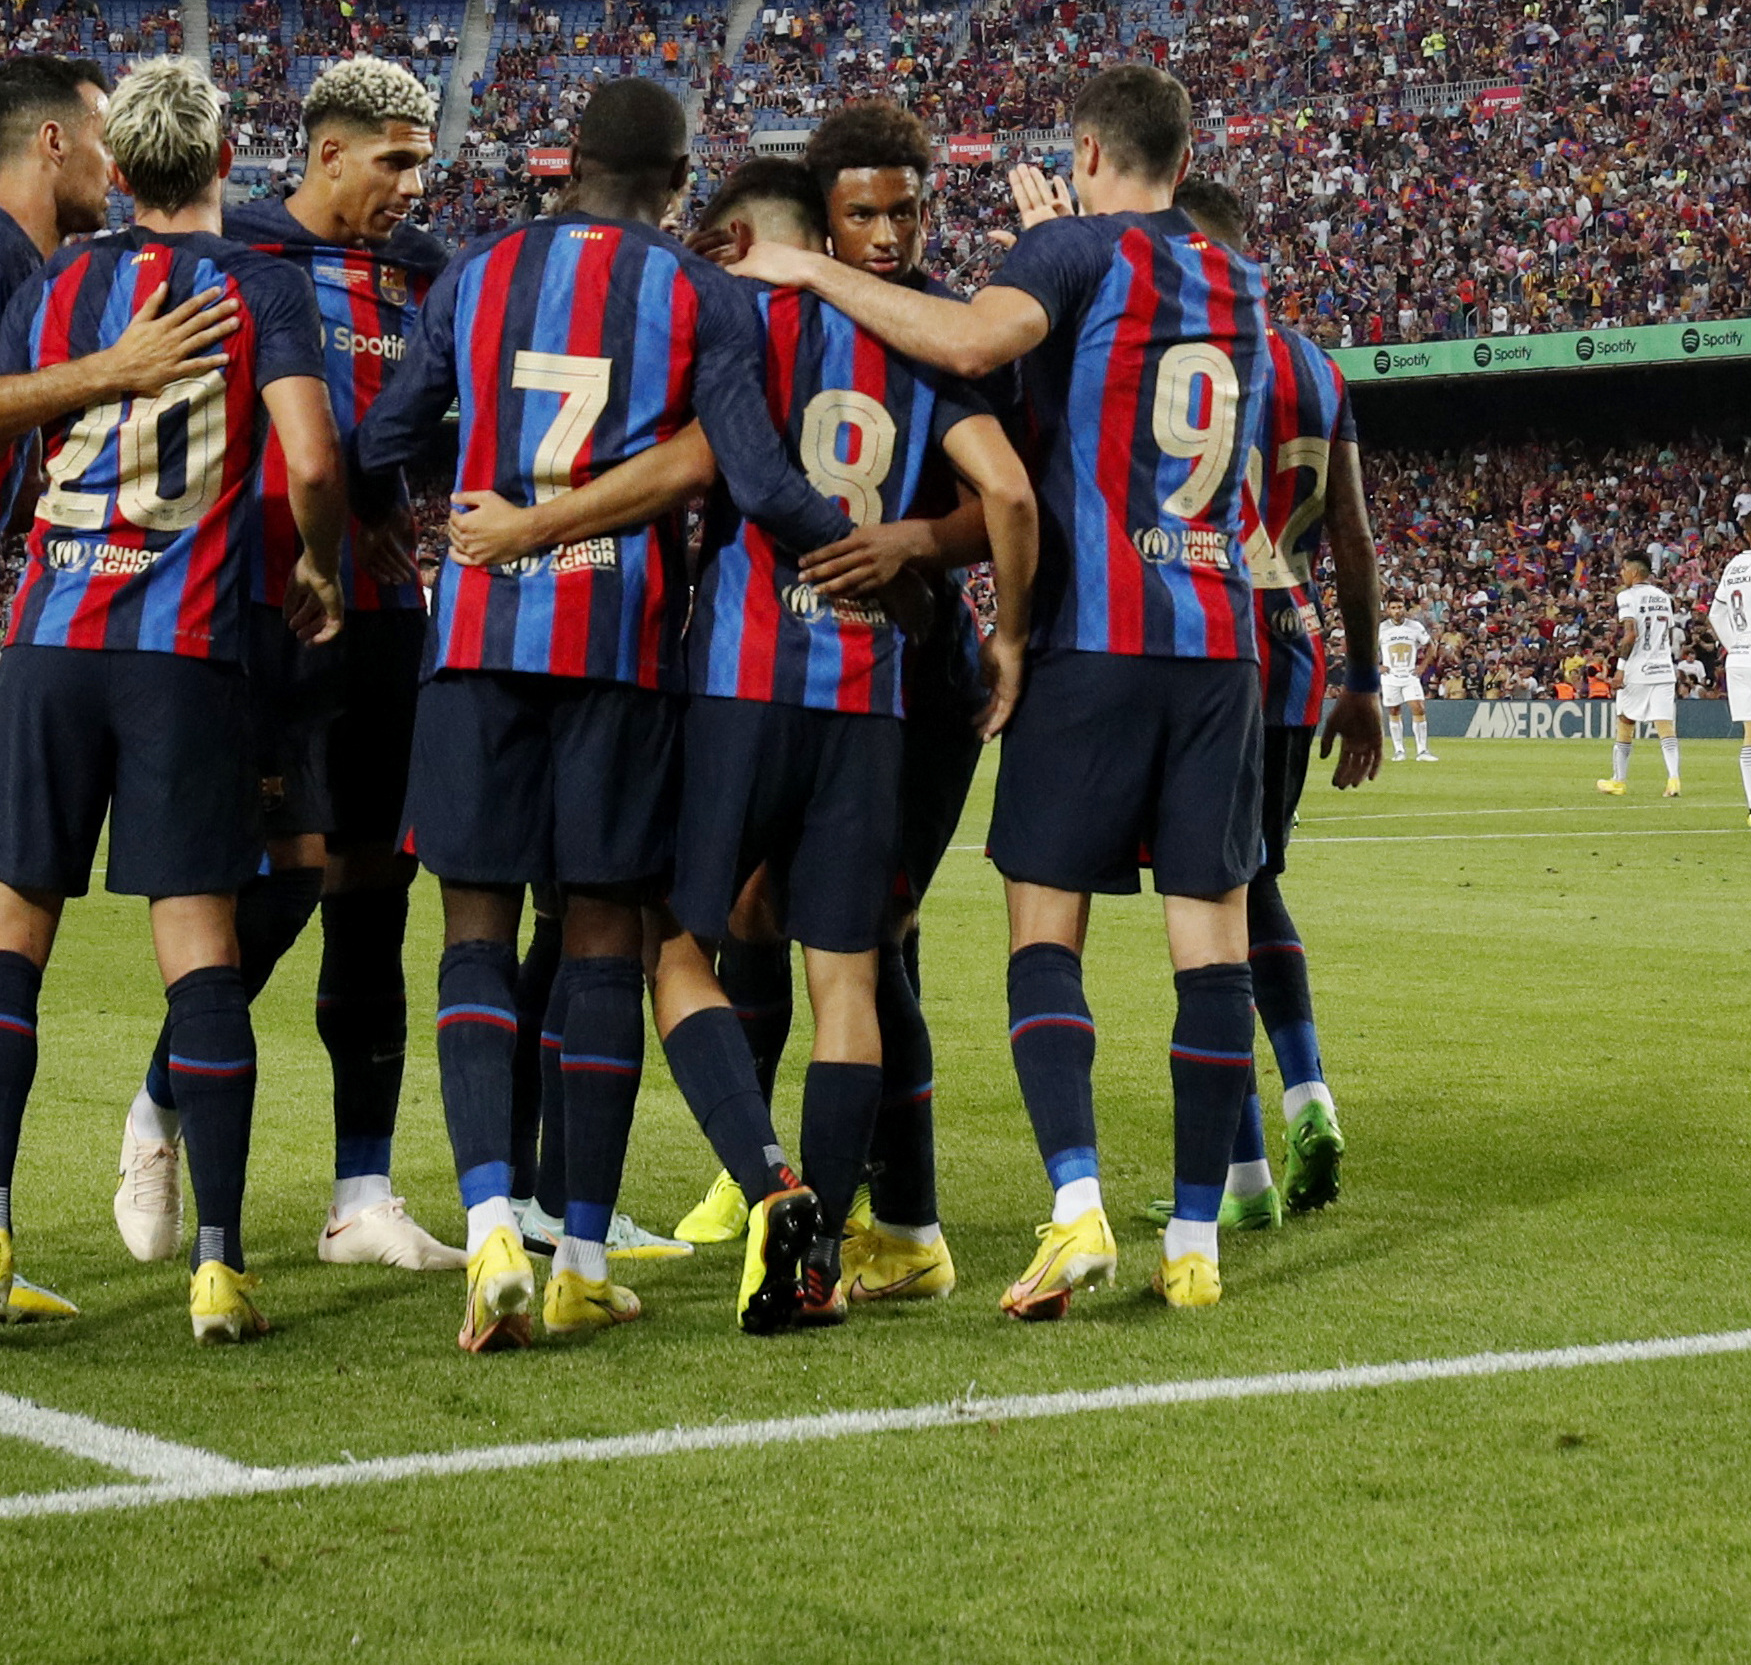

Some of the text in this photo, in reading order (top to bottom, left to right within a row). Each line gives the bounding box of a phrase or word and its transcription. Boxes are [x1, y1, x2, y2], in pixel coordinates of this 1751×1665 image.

[539, 158, 570, 166] ESTRELL
[334, 326, 406, 361] Spotif
[1597, 339, 1636, 355] Spotify
[1703, 332, 1744, 349] Spotify
[1393, 354, 1431, 370] Spotify
[1494, 347, 1532, 363] Spotify
[511, 350, 613, 506] 7
[1152, 341, 1239, 519] 9
[34, 369, 227, 532] 20
[800, 388, 897, 527] 8
[89, 557, 152, 574] ACNU
[548, 550, 616, 571] ACNUR
[1727, 575, 1751, 587] SUZUKI
[1731, 589, 1748, 632] 8
[1642, 616, 1669, 651] 17
